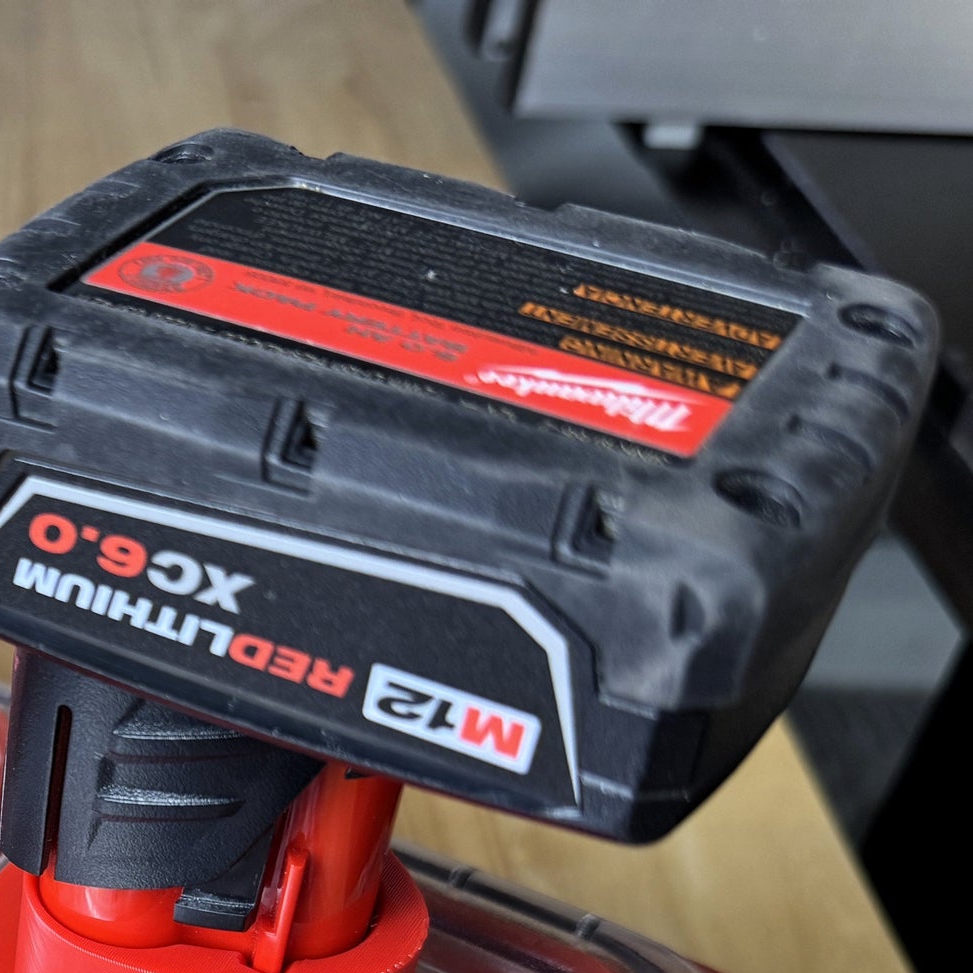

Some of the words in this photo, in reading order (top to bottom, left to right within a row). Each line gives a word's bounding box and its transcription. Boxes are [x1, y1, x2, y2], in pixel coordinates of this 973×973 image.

[477, 371, 692, 432] Milwaukee
[28, 512, 254, 615] XC6.0
[378, 682, 525, 760] M12
